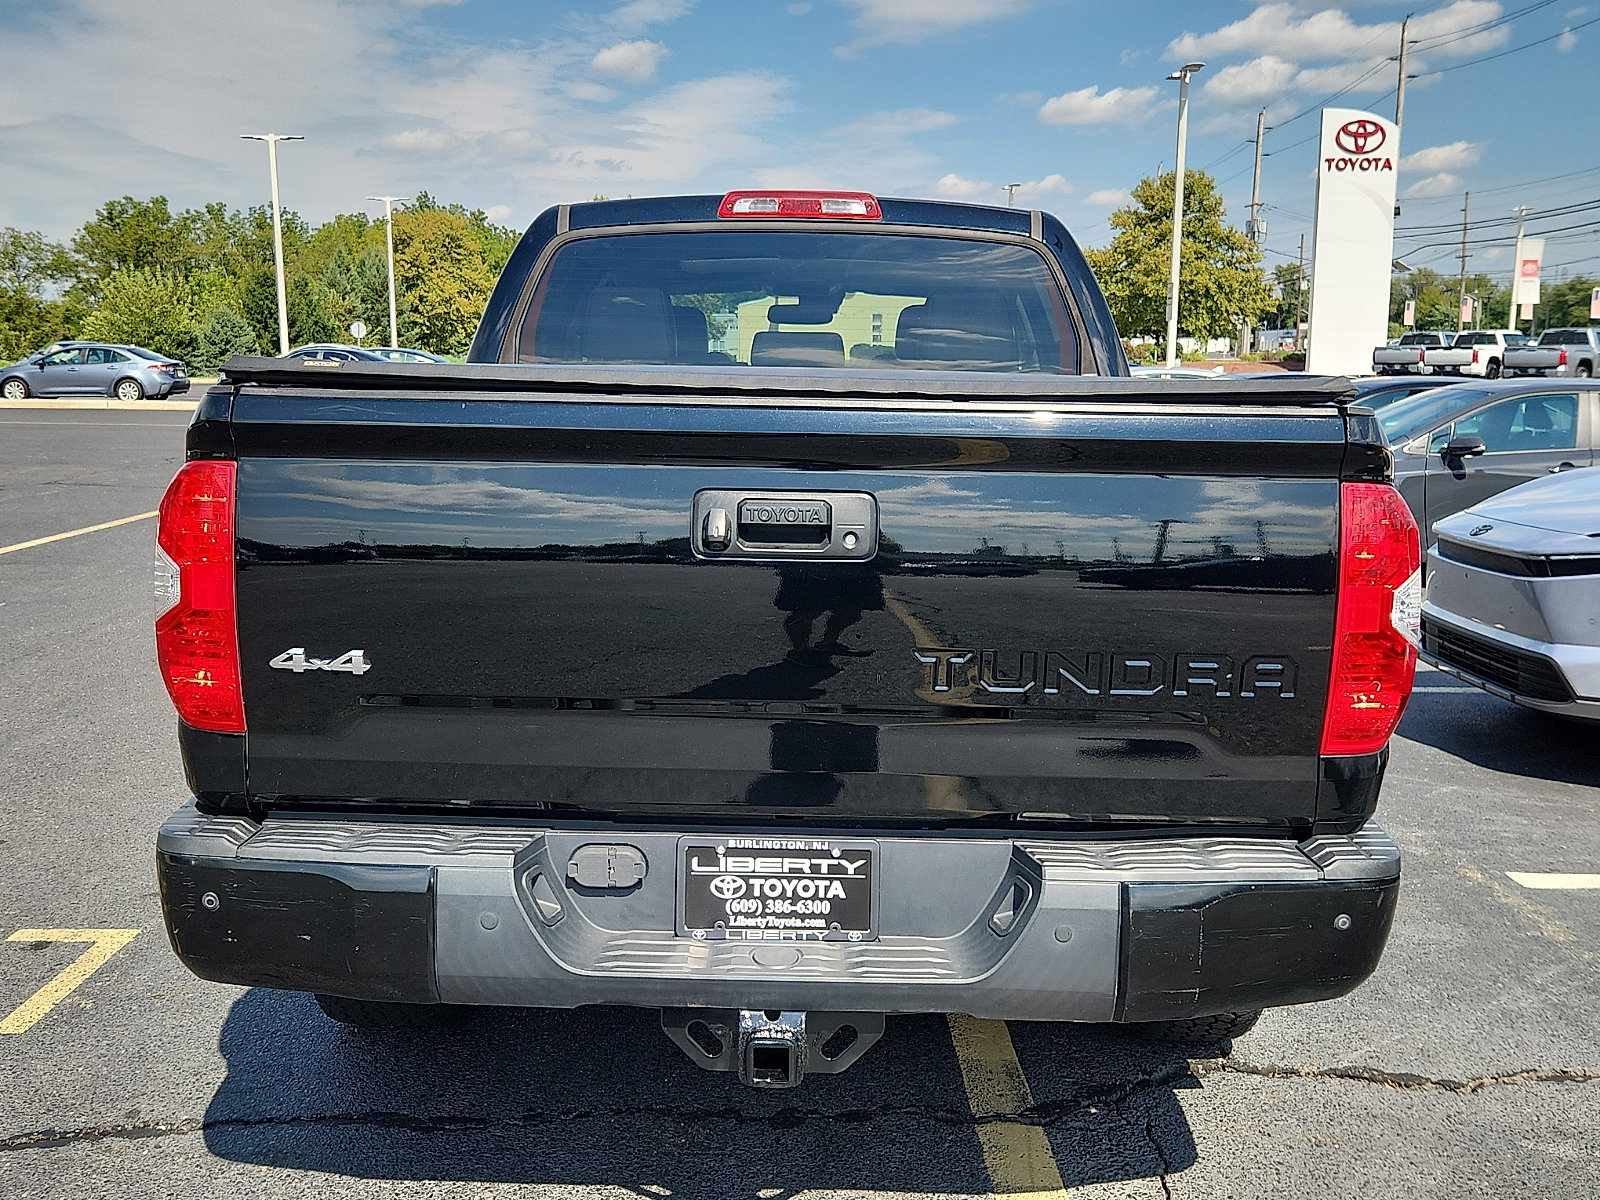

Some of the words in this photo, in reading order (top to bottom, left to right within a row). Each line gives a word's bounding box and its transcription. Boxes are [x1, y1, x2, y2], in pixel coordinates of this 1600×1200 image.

[1325, 157, 1392, 172] TOYOTA
[745, 506, 823, 523] TOYOTA
[911, 647, 1299, 698] TUNDRA
[728, 839, 808, 851] BURLINGTON,
[812, 841, 829, 851] NJ
[749, 878, 847, 899] TOYOTA
[725, 899, 763, 916] (609)
[765, 900, 831, 915] 386-6300
[729, 916, 827, 929] LibertyToyota.com
[725, 930, 829, 941] LIBERTY
